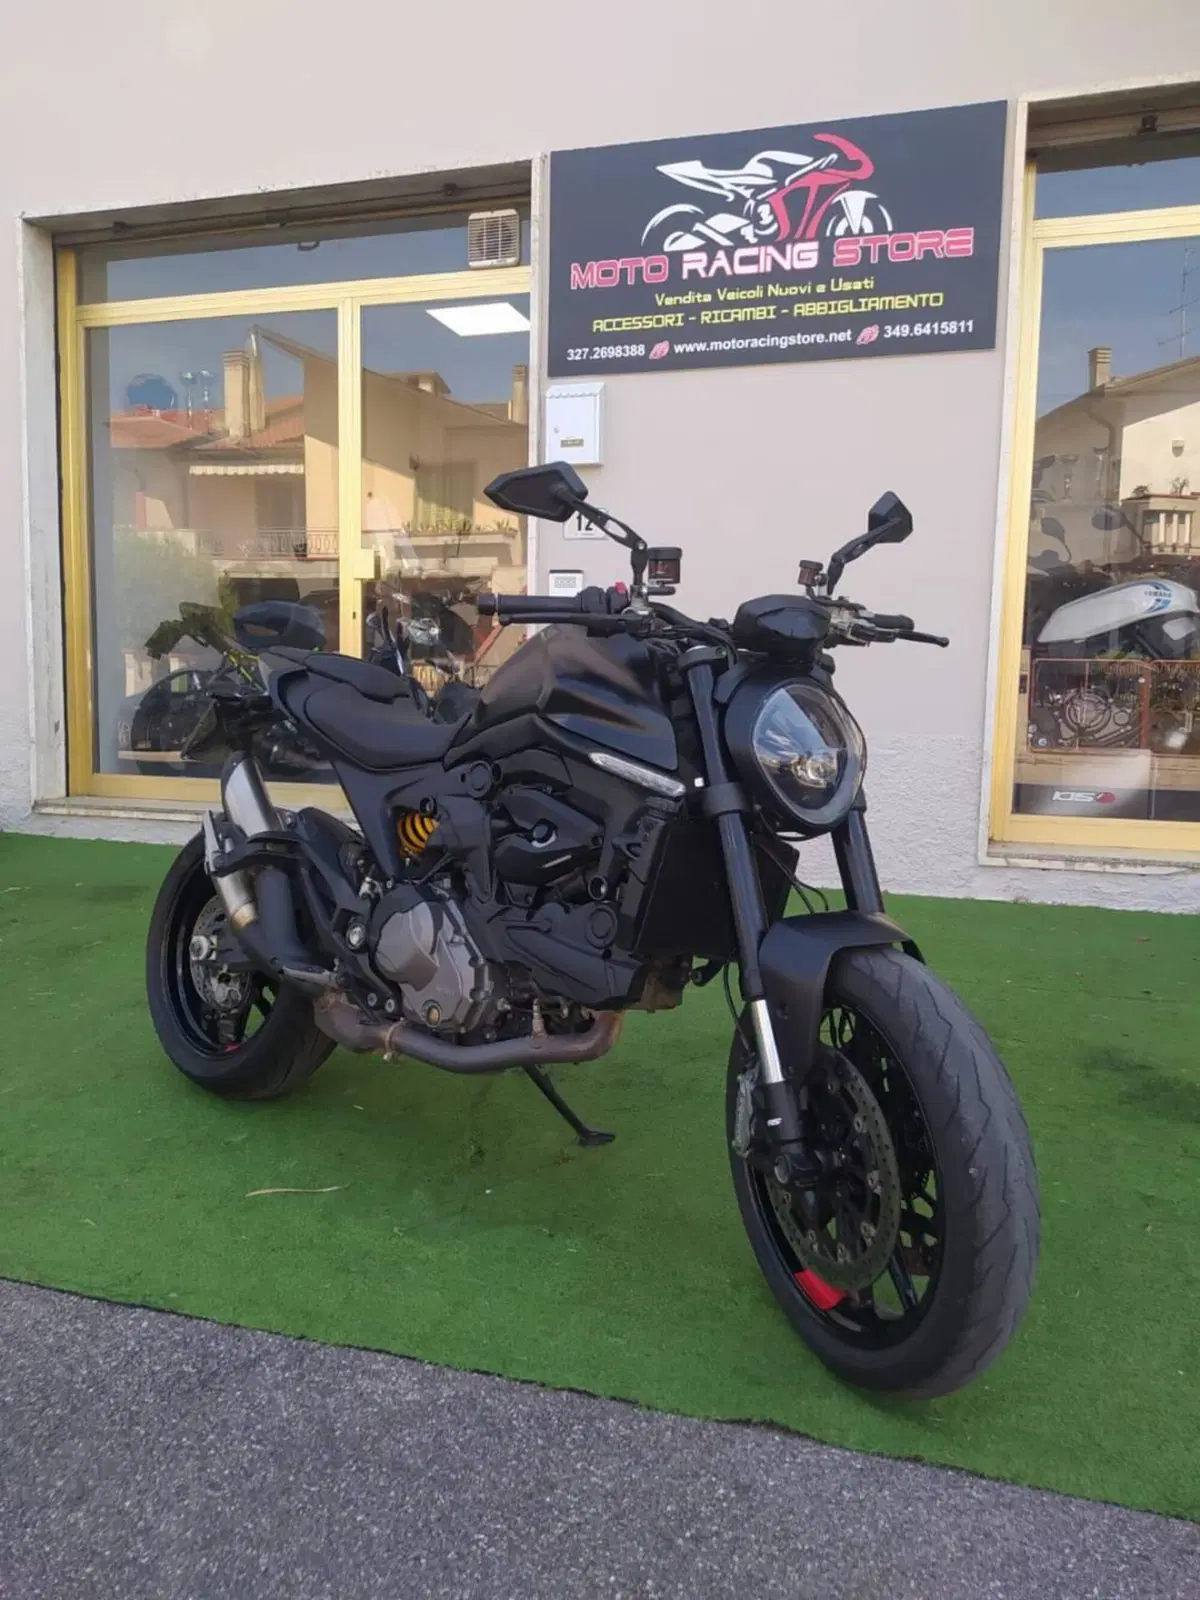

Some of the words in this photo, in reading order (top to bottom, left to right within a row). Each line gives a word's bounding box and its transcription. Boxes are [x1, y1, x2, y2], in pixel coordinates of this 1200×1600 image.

[570, 255, 669, 290] MOTO
[682, 241, 819, 280] RACING
[833, 227, 974, 267] STORE
[655, 291, 712, 306] Vendita
[717, 285, 764, 301] Veicoli
[767, 280, 812, 298] Nuovi
[816, 283, 826, 294] e
[830, 276, 875, 293] Usati
[592, 313, 685, 332] ACCESSORI
[700, 305, 777, 324] RICAMBI
[793, 292, 944, 317] ABBIGLIAMENTO
[567, 344, 646, 361] 327.2698388
[673, 329, 852, 354] www.motoracingstore.net
[883, 319, 974, 339] 349.6415811
